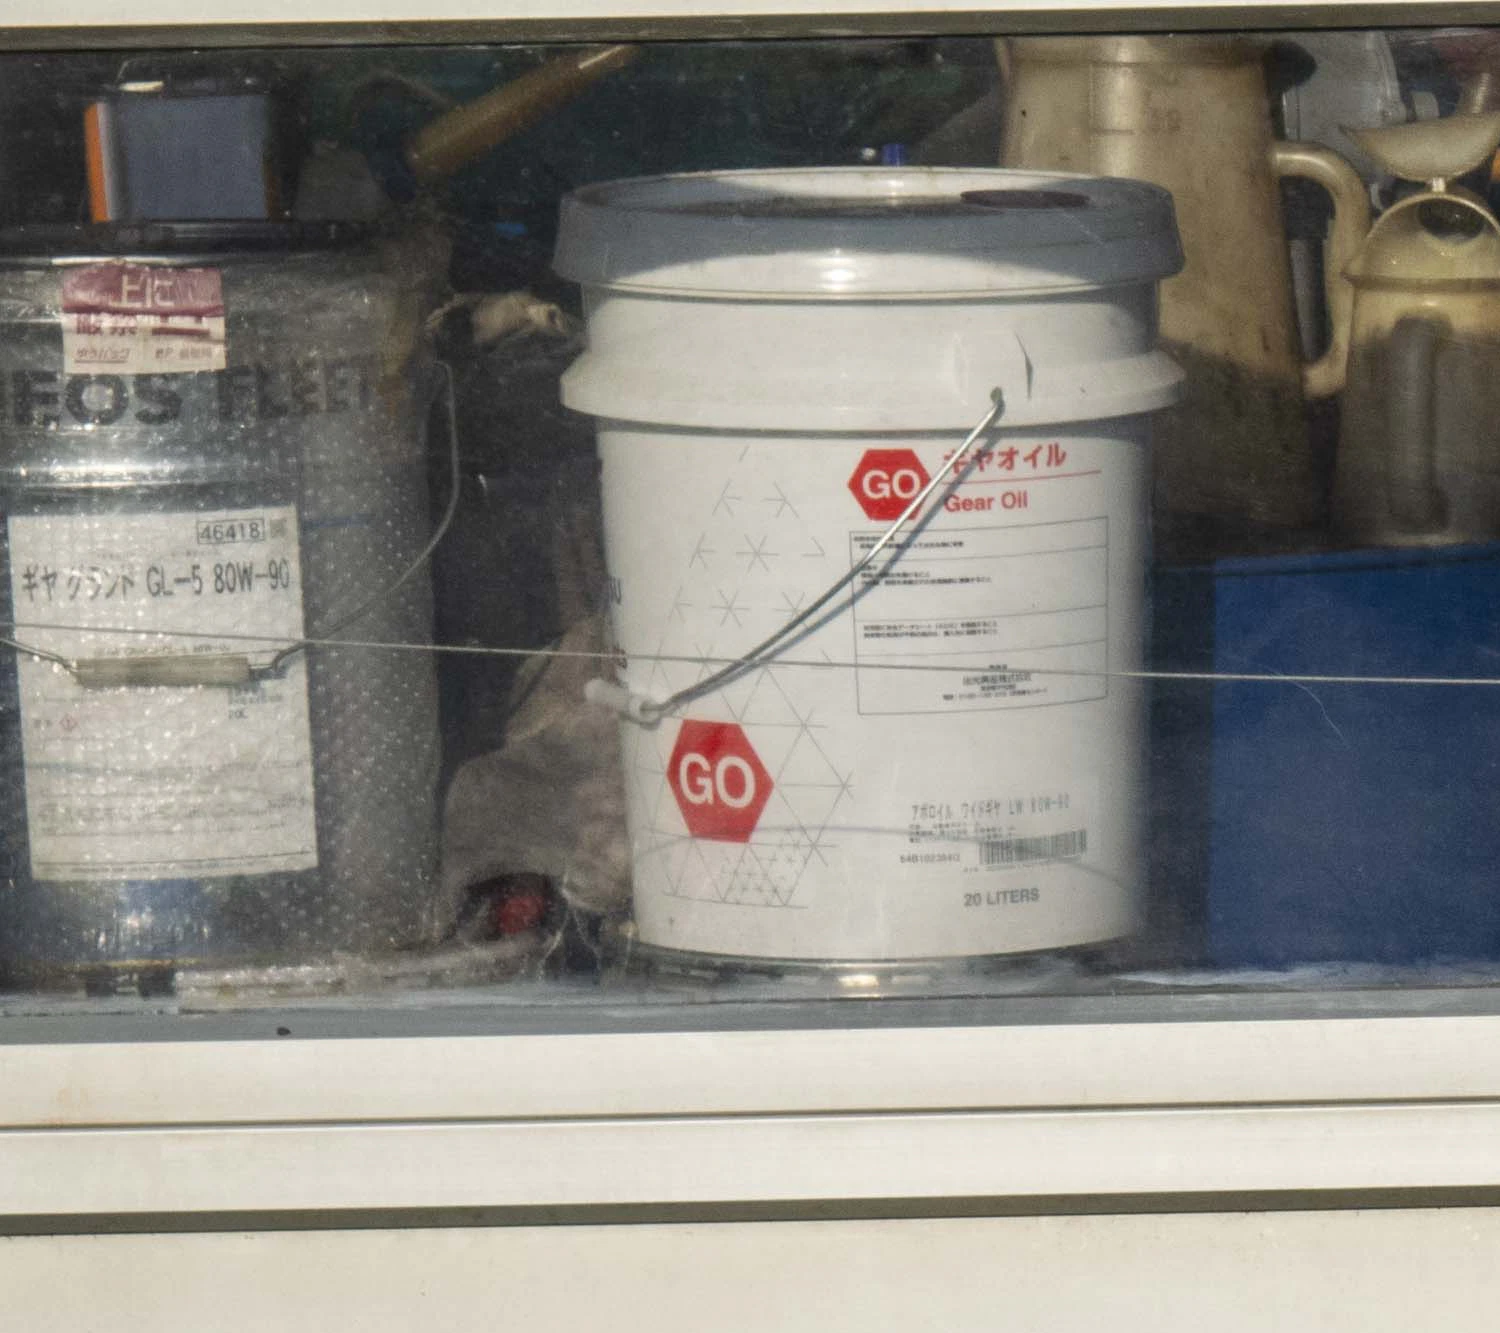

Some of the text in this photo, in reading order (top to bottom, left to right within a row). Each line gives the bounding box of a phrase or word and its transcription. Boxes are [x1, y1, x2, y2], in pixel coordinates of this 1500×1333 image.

[862, 469, 922, 499] GO
[943, 490, 1029, 513] Gear Oil
[200, 522, 263, 542] 46418
[213, 557, 290, 595] 80W-90
[679, 752, 756, 809] GO
[963, 887, 1041, 908] 20 LITERS
